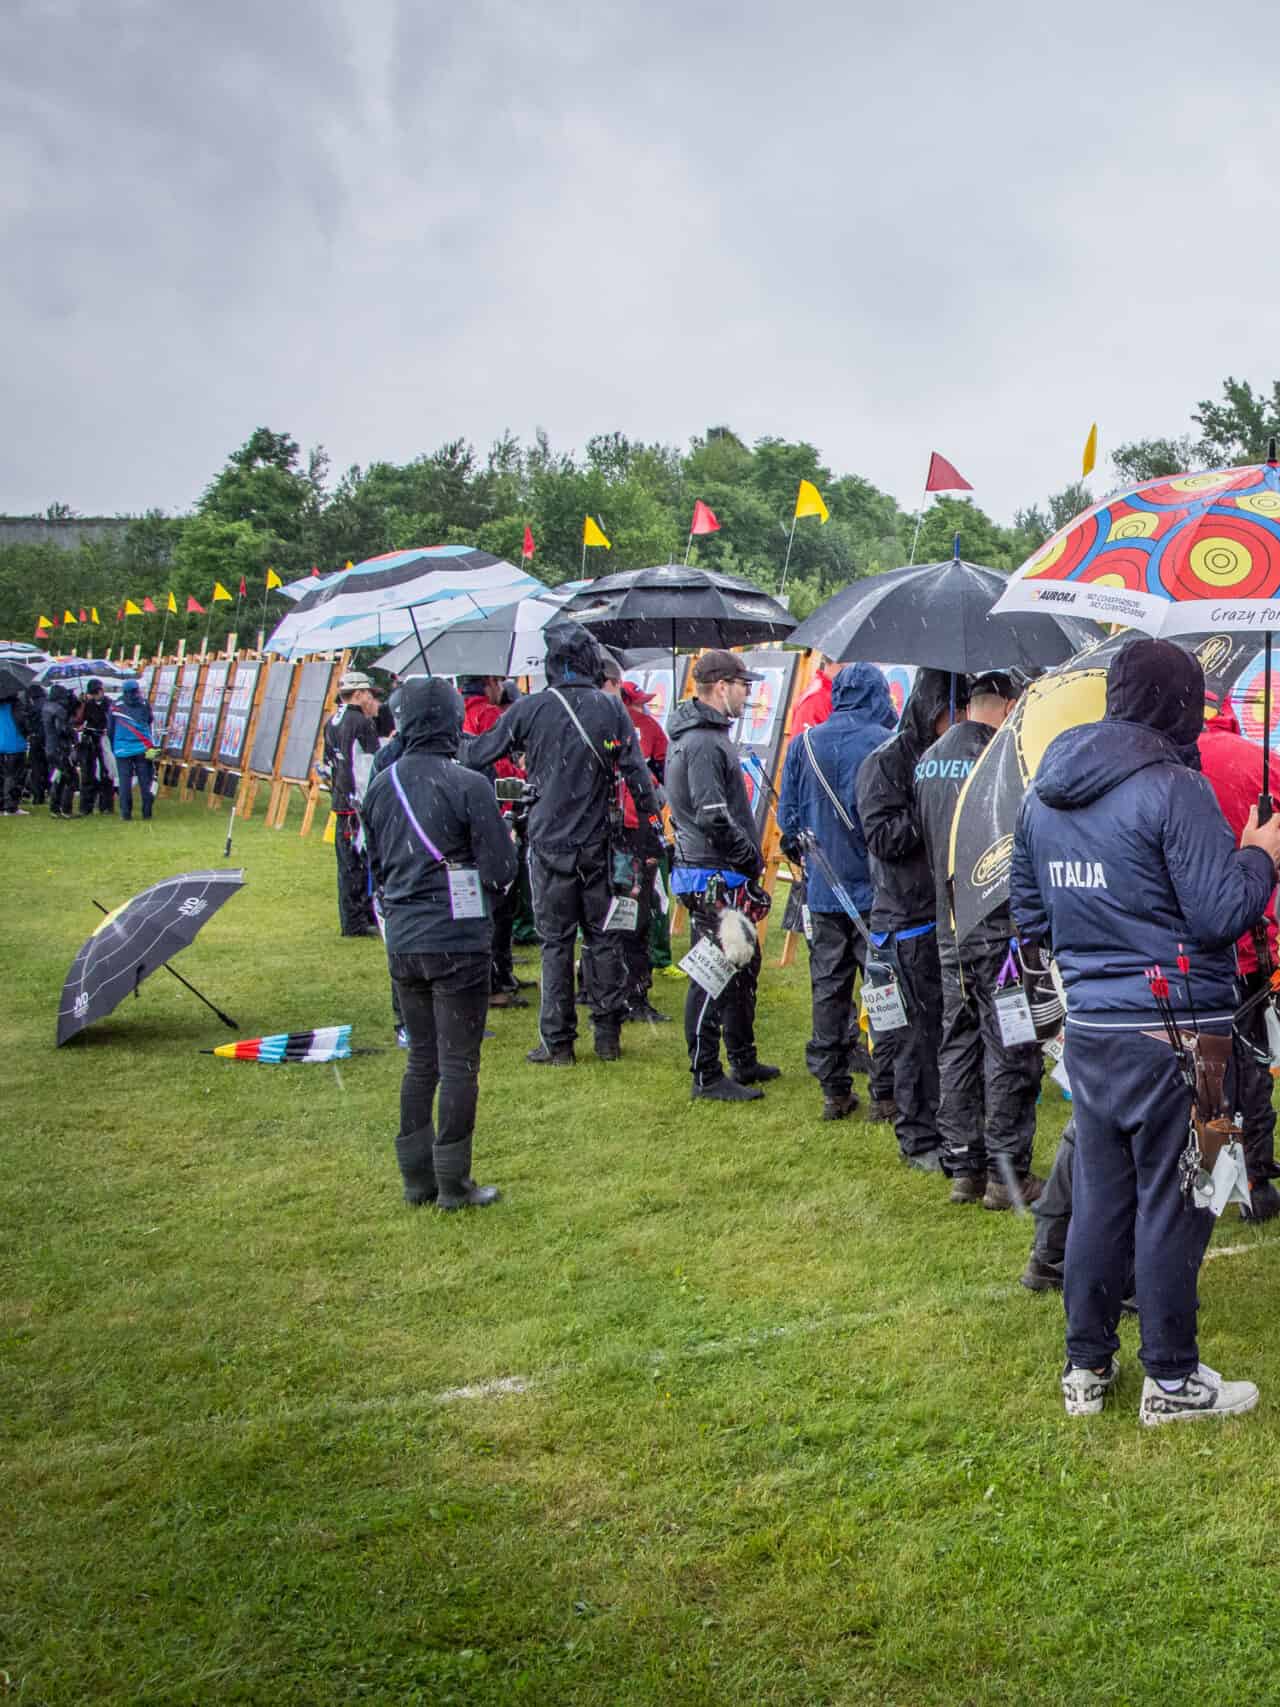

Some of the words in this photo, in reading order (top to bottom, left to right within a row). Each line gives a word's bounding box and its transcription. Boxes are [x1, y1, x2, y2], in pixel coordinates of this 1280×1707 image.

[1040, 589, 1078, 603] AURORA
[1211, 607, 1256, 625] Crazy
[1048, 861, 1108, 889] ITALIA
